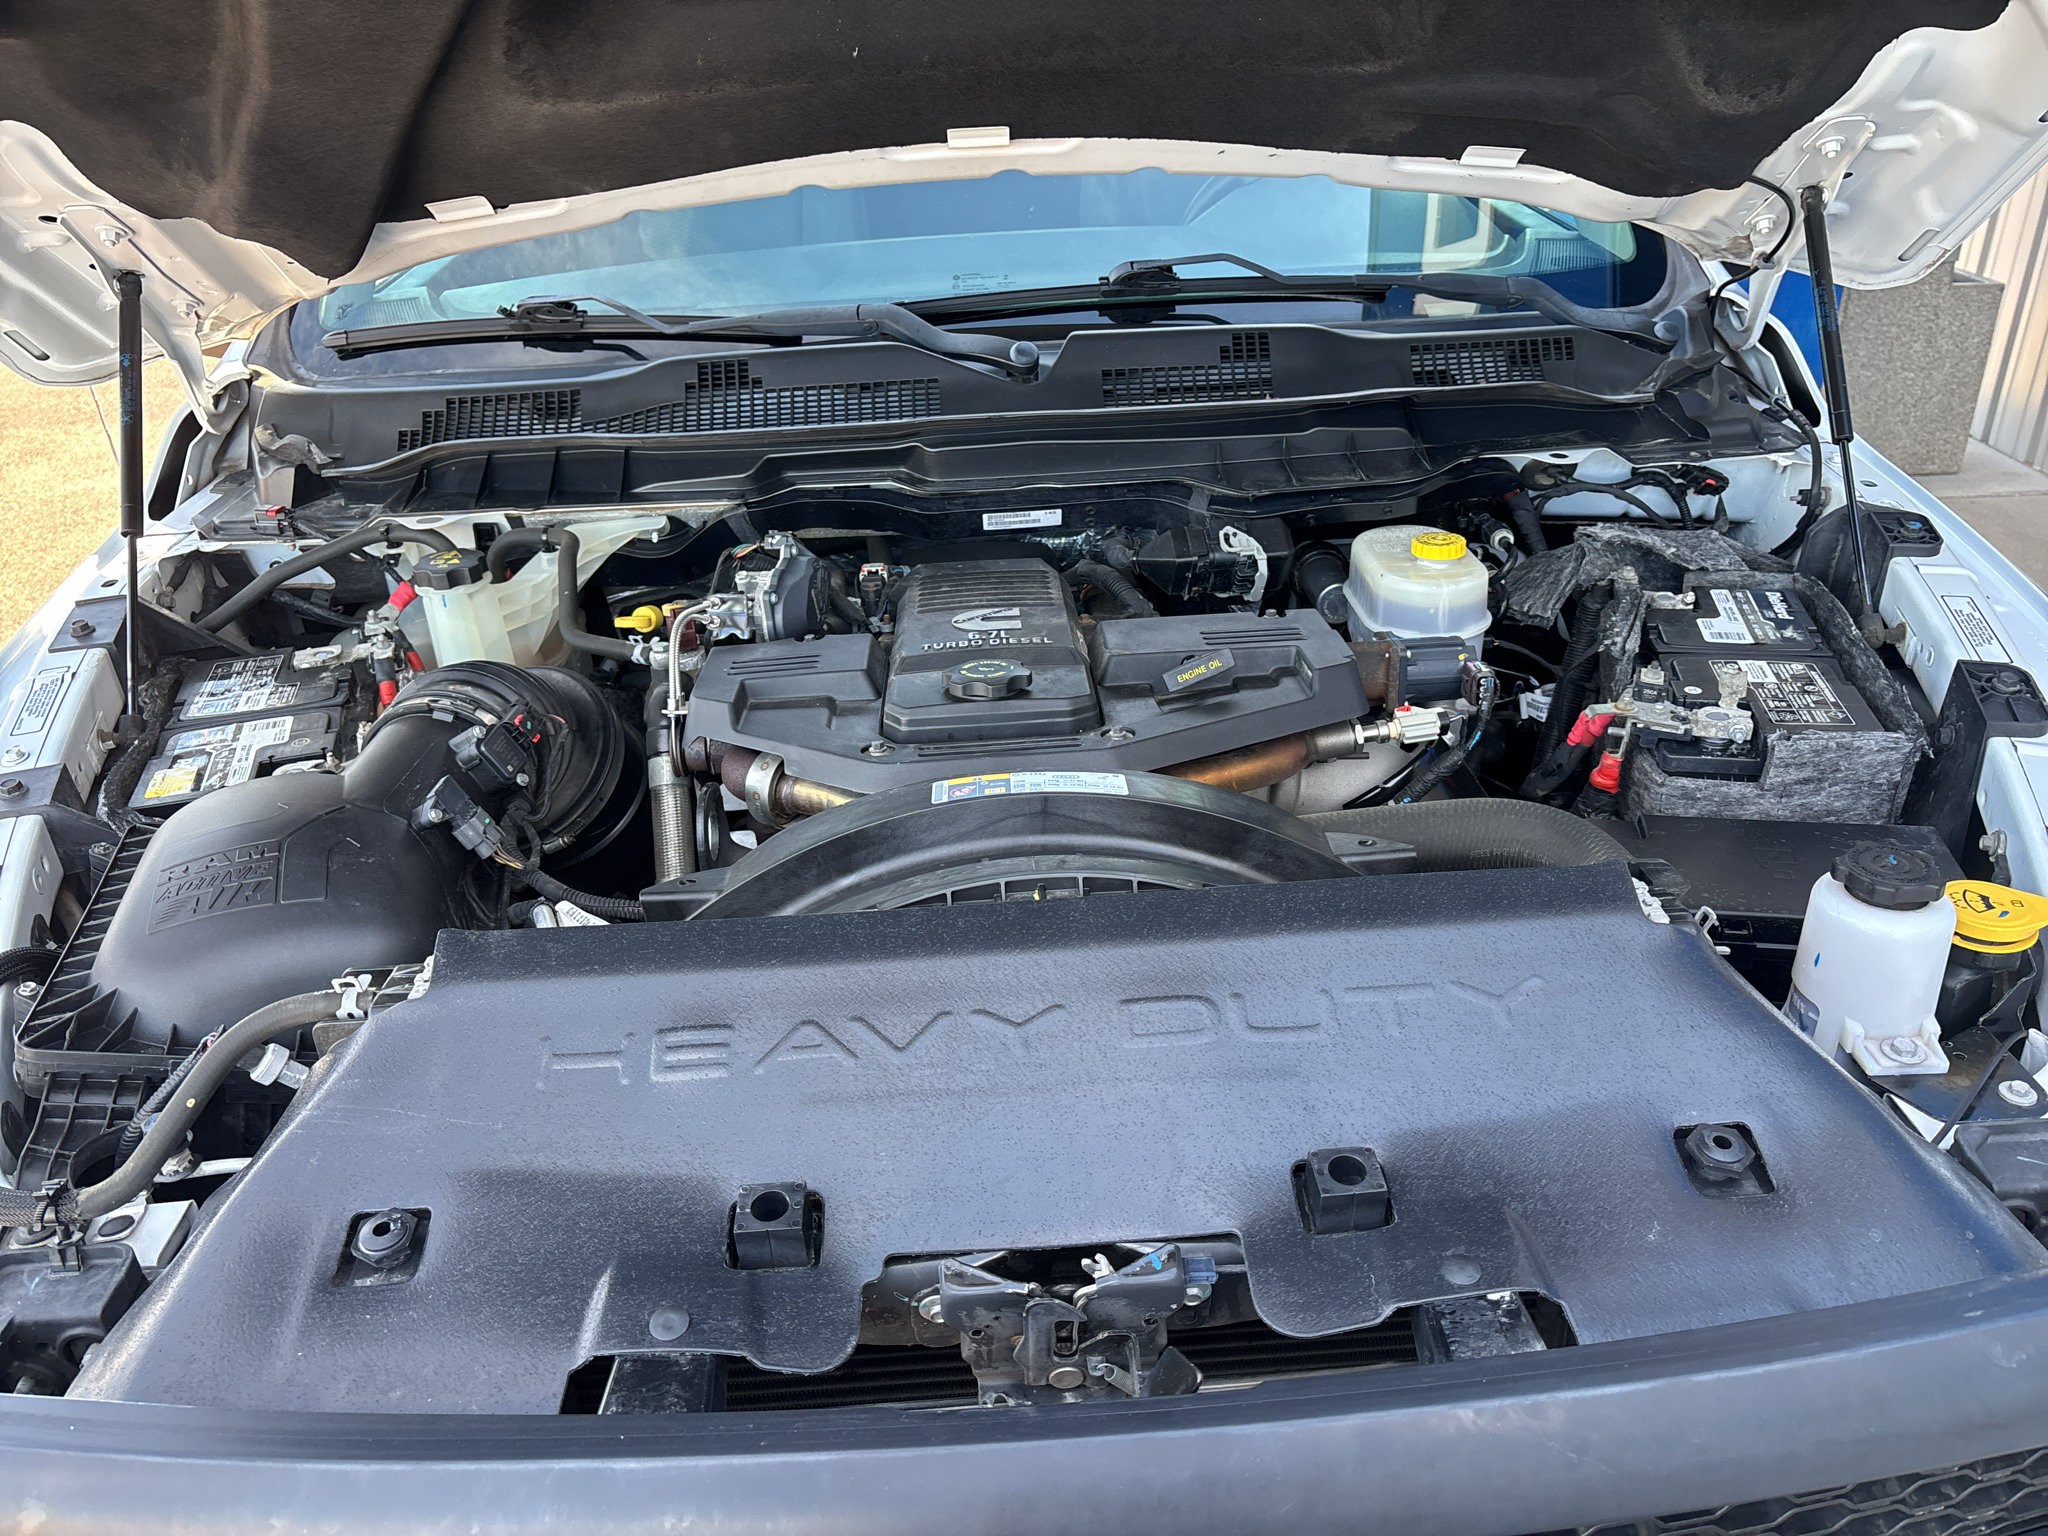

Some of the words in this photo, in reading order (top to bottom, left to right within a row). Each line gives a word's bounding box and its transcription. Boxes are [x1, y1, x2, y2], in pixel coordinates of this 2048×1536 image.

[953, 606, 1015, 625] Cummins
[921, 639, 983, 651] TURBO
[989, 636, 1053, 646] DIESEL
[967, 630, 1010, 640] 6.7L
[1176, 664, 1208, 683] ENGINE
[1208, 658, 1223, 670] OIL
[533, 1003, 1067, 1091] HEAVY
[1115, 972, 1547, 1052] DUTY
